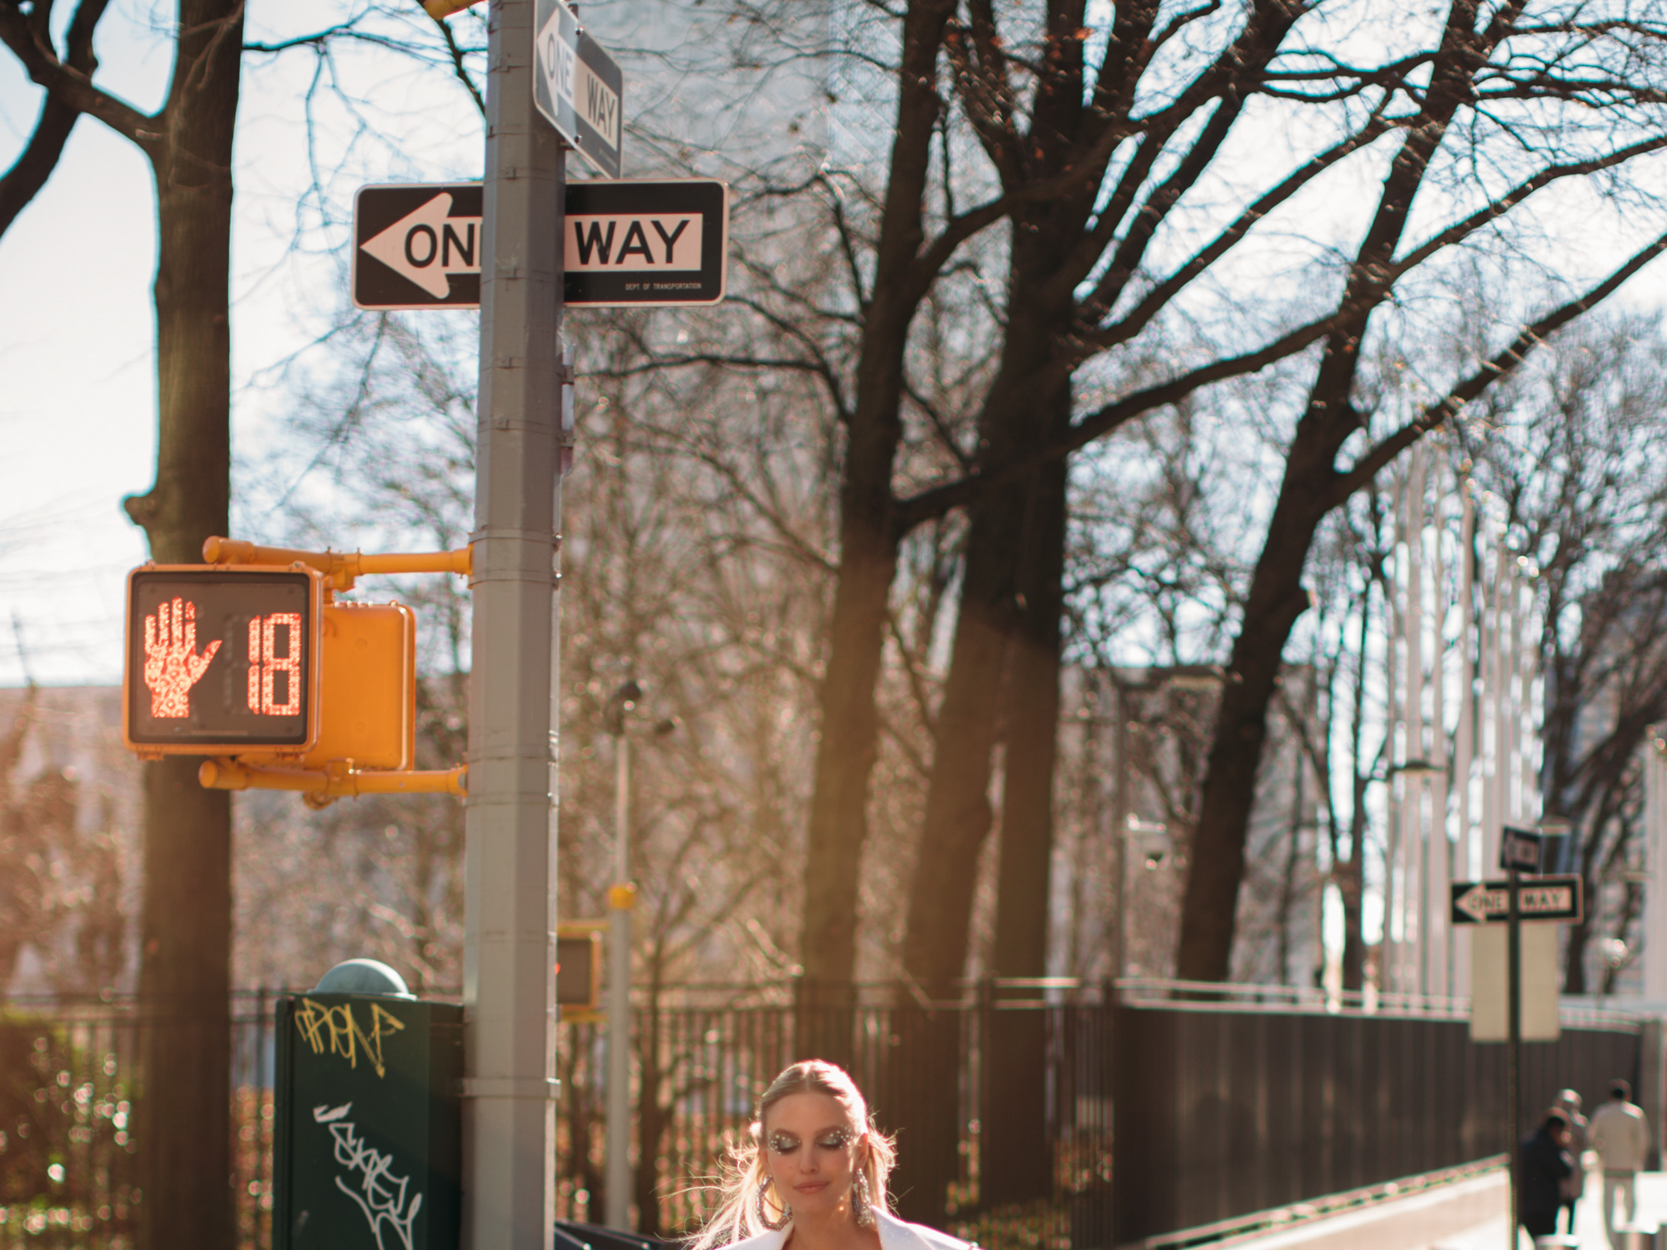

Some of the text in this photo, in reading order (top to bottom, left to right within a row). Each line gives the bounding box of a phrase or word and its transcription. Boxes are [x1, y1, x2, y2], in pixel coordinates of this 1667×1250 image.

[547, 32, 615, 139] ONE WAY
[404, 219, 690, 268] ON WAY
[653, 282, 702, 290] TRANSPORTATION
[248, 613, 300, 715] 18
[1468, 891, 1562, 912] ONE WAY
